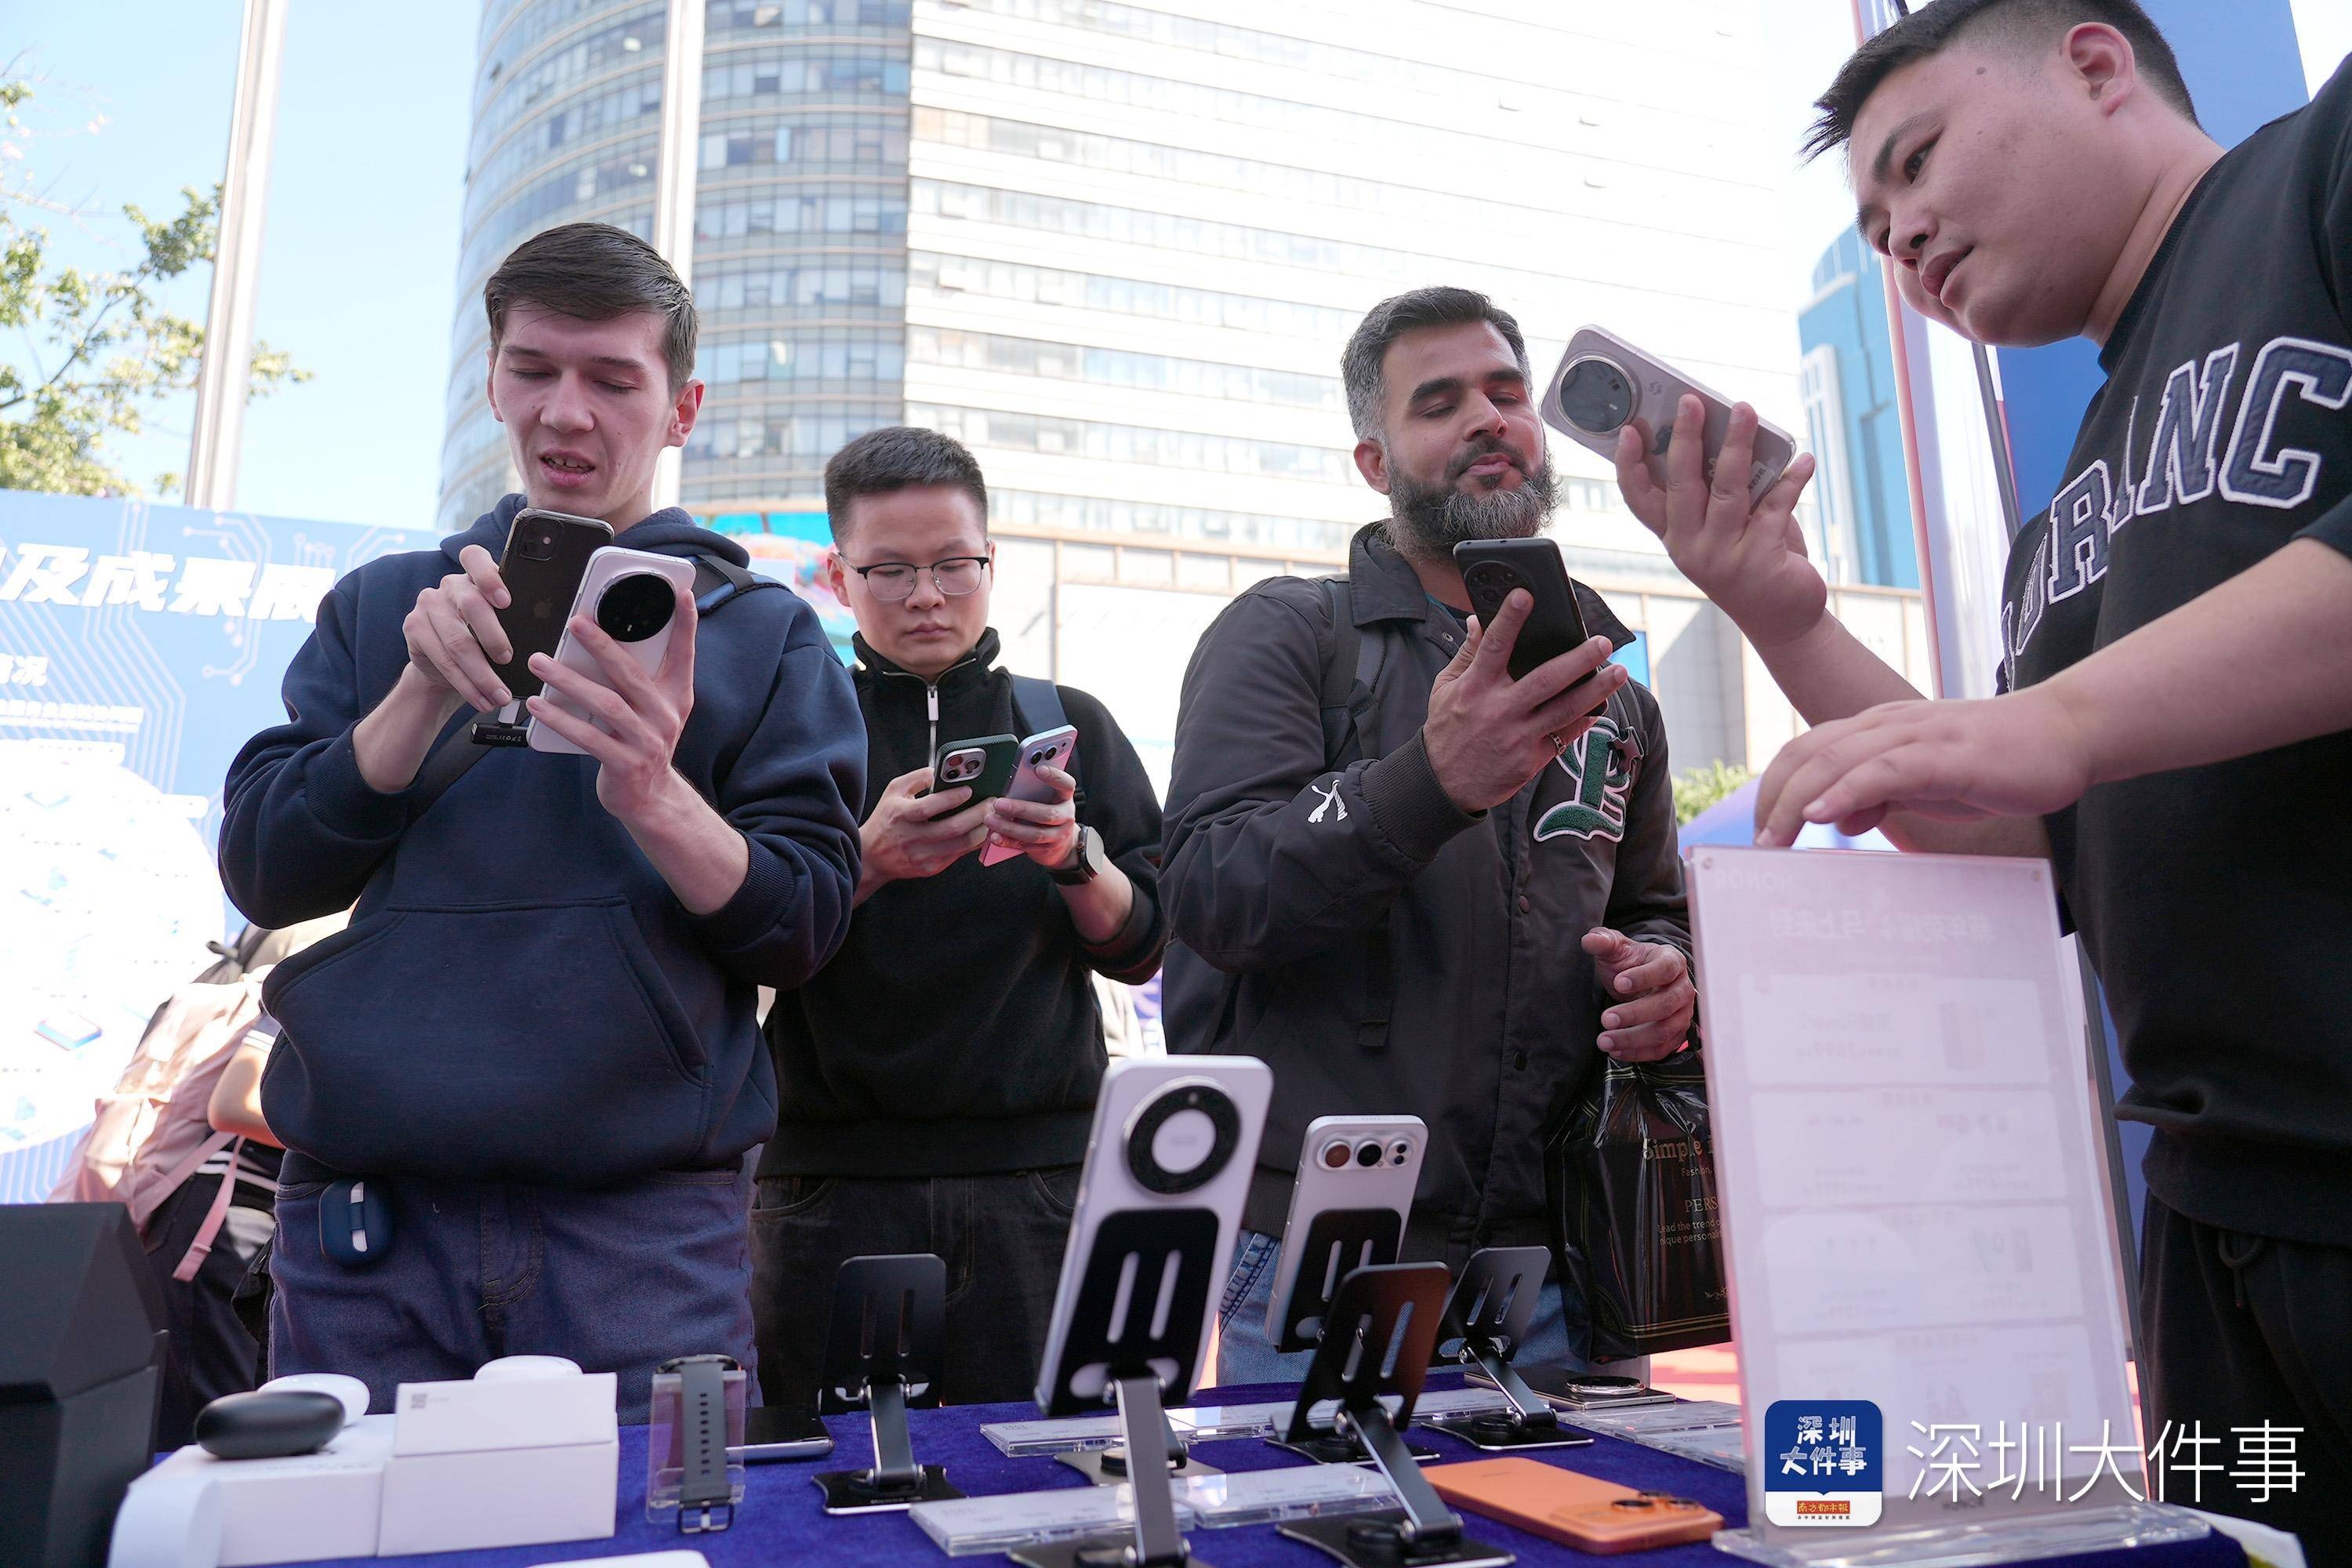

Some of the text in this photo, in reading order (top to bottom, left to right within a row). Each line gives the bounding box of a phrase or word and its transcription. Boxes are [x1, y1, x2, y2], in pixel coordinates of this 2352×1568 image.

[0, 543, 336, 623] 及成果展
[1677, 1221, 1691, 1232] the
[1692, 1218, 1715, 1230] trend
